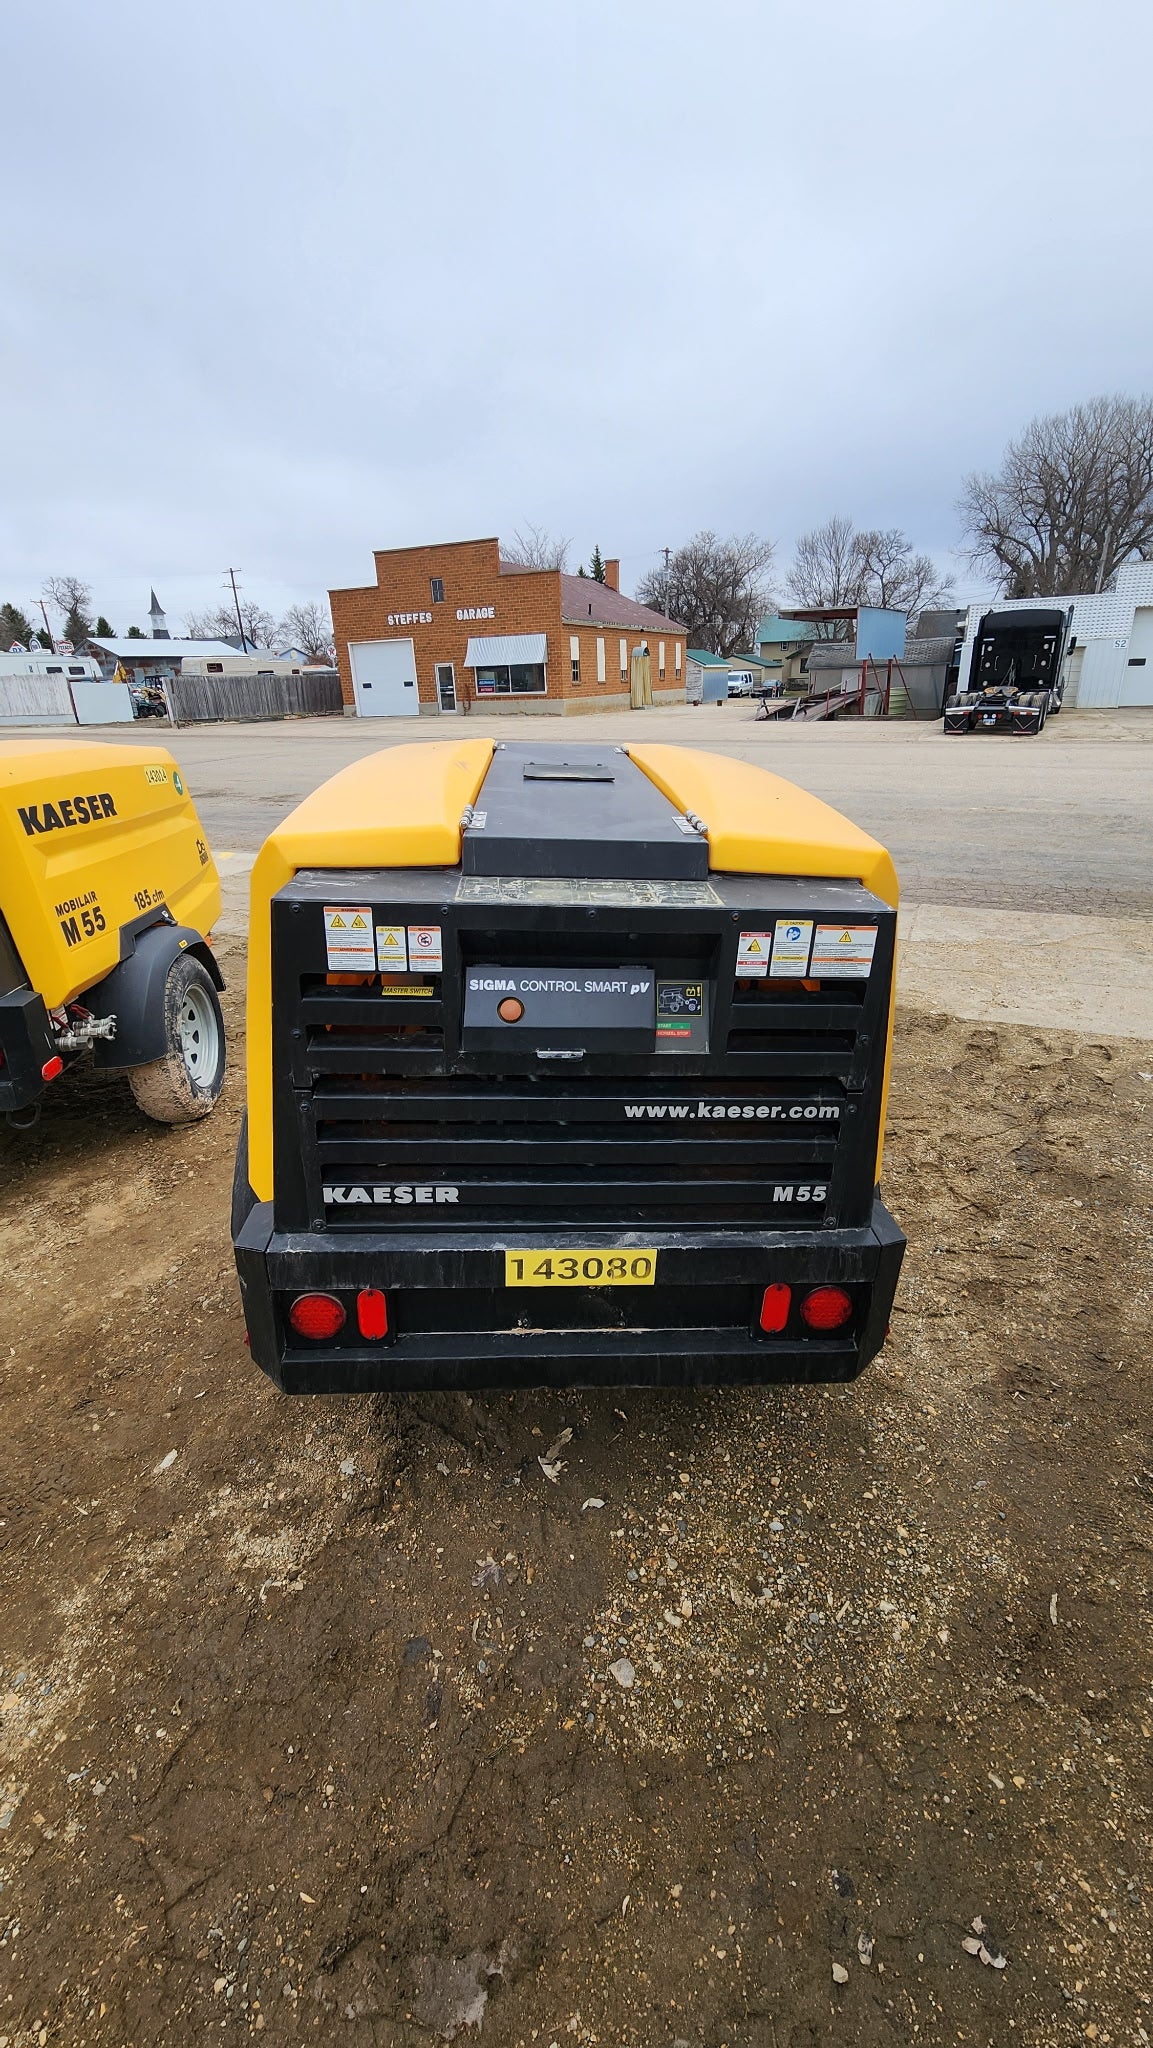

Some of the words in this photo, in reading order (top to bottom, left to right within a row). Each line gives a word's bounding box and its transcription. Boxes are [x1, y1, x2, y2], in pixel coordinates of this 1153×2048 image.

[387, 612, 433, 625] STEFFES
[456, 607, 495, 620] GARAGE
[17, 793, 118, 836] KAESER
[55, 890, 98, 917] MOBILAIR
[134, 889, 152, 911] 185
[152, 889, 165, 903] cfm
[60, 916, 82, 948] M
[80, 905, 106, 937] 55
[469, 979, 517, 991] SIGMA
[520, 980, 582, 993] CONTROL
[584, 981, 628, 994] SMART
[630, 982, 650, 995] pV
[624, 1102, 840, 1119] www.kaeser.com
[322, 1186, 460, 1204] KAESER
[510, 1257, 652, 1280] 143080
